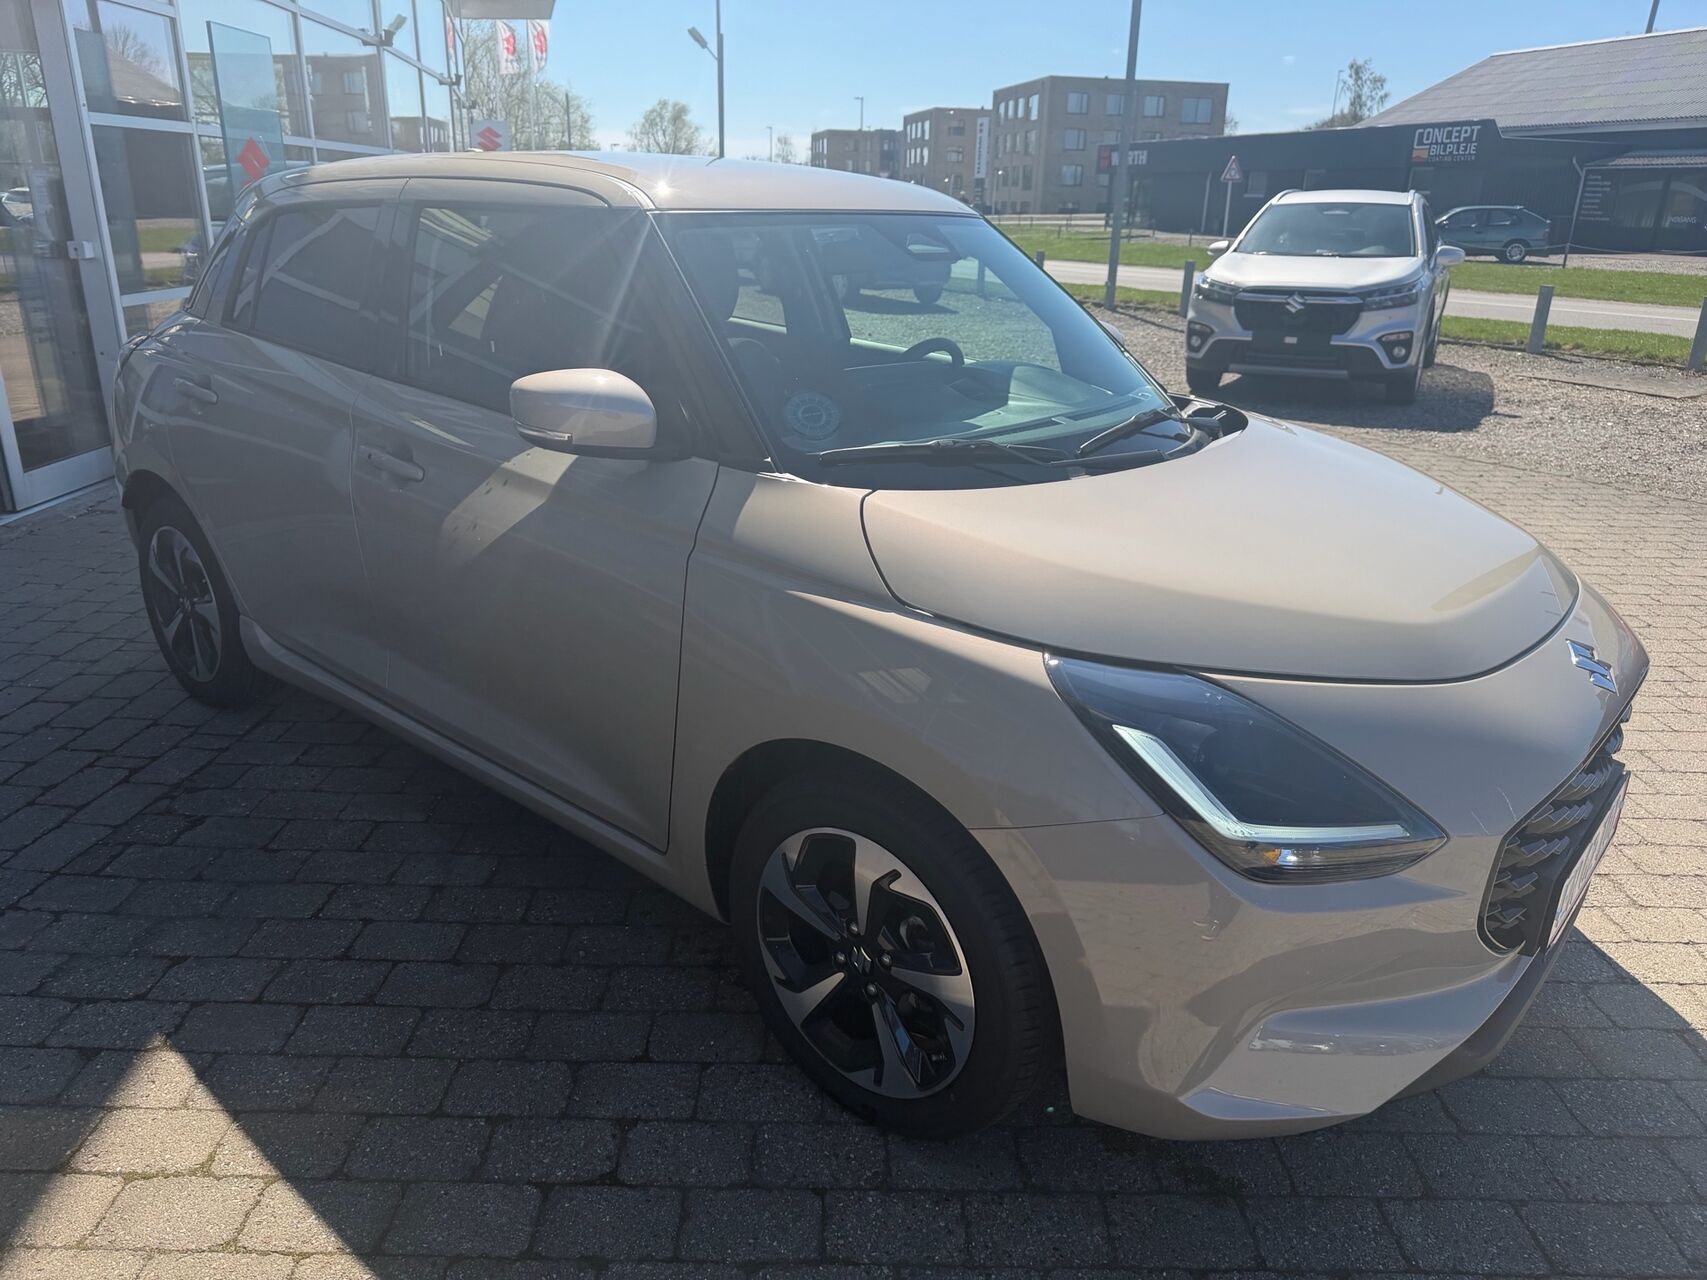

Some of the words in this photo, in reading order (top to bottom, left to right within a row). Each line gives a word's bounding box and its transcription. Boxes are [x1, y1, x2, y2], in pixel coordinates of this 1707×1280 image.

[1414, 126, 1481, 148] CONCEPT
[1430, 143, 1477, 155] BILPLEJE
[1111, 150, 1148, 166] WRTH
